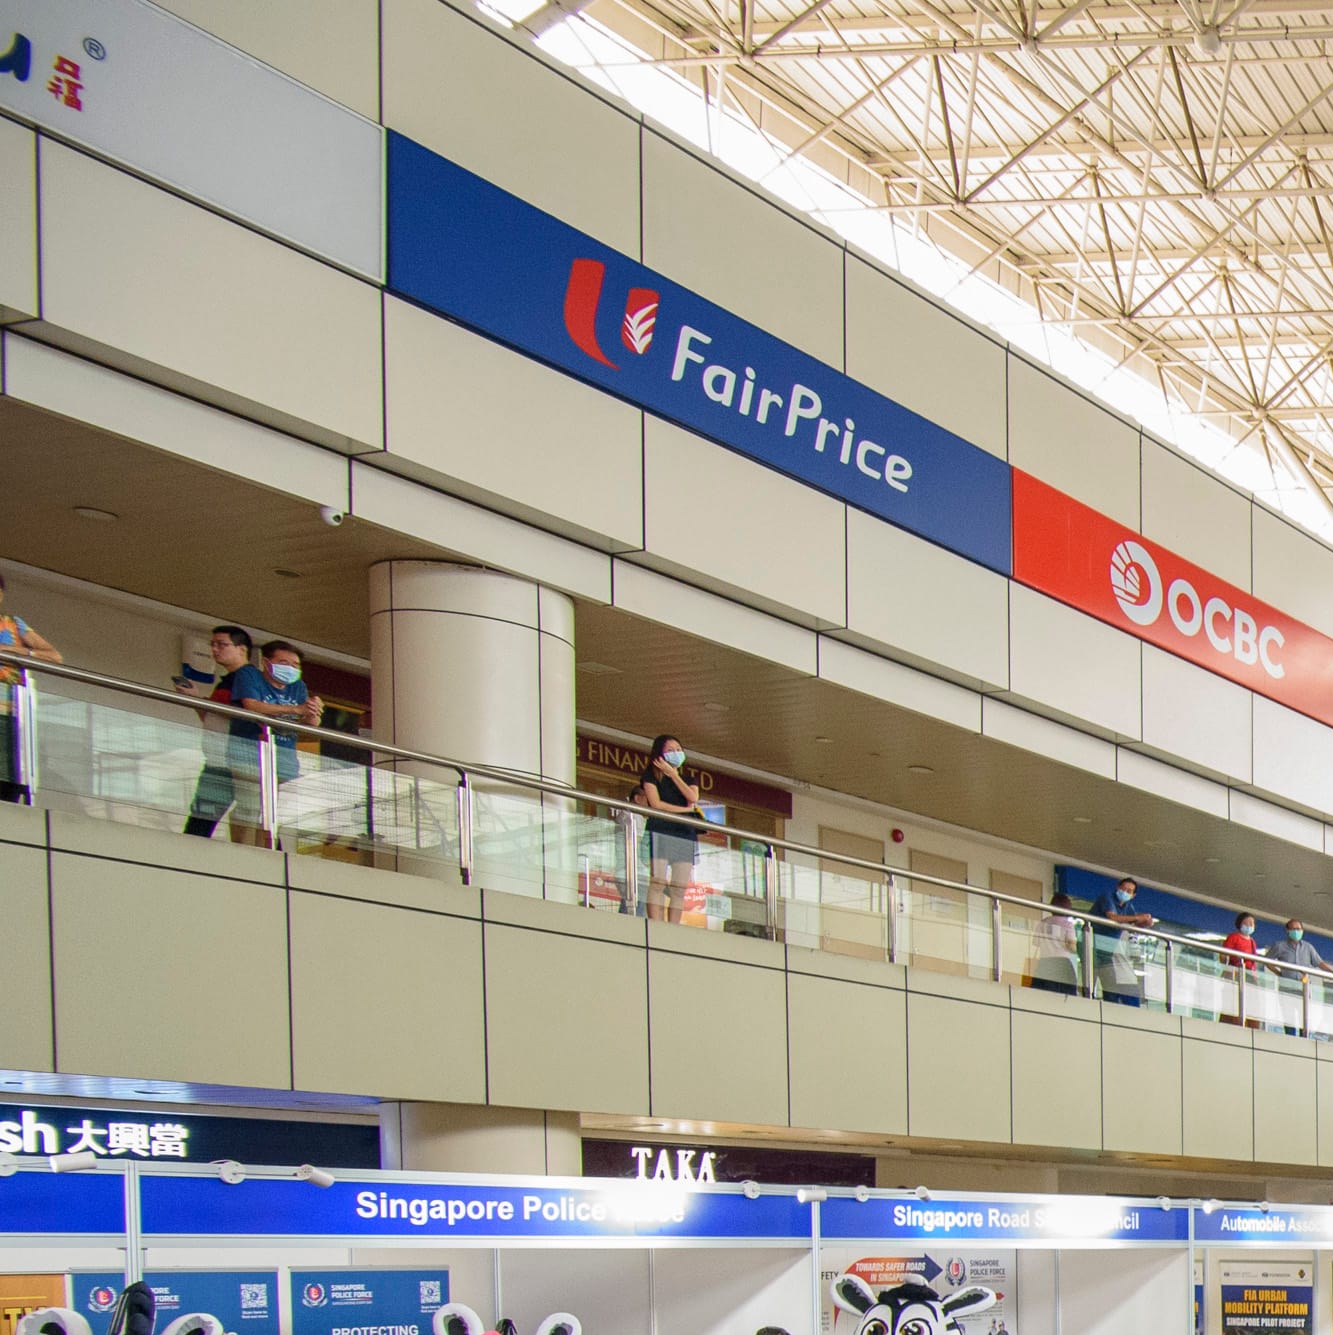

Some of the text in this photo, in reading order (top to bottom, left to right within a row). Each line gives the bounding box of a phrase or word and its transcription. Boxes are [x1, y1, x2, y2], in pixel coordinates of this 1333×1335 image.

[671, 325, 913, 493] FairPrice
[1167, 578, 1286, 679] OCBC
[66, 1120, 189, 1158] 大興當
[632, 1147, 715, 1184] TAKA
[356, 1191, 514, 1226] Singapore
[523, 1196, 606, 1222] Police
[893, 1205, 983, 1231] Singapore
[988, 1208, 1029, 1228] Road
[1220, 1215, 1286, 1232] Automobile
[856, 1262, 926, 1272] TOWARDS SAFER ROADS
[870, 1273, 905, 1282] IN SINGAPO
[1244, 1289, 1287, 1301] FIA URBAN
[1225, 1302, 1308, 1315] MOBILITY PLATFORM
[1226, 1317, 1306, 1328] SINGAPORE PILOT PROJECT
